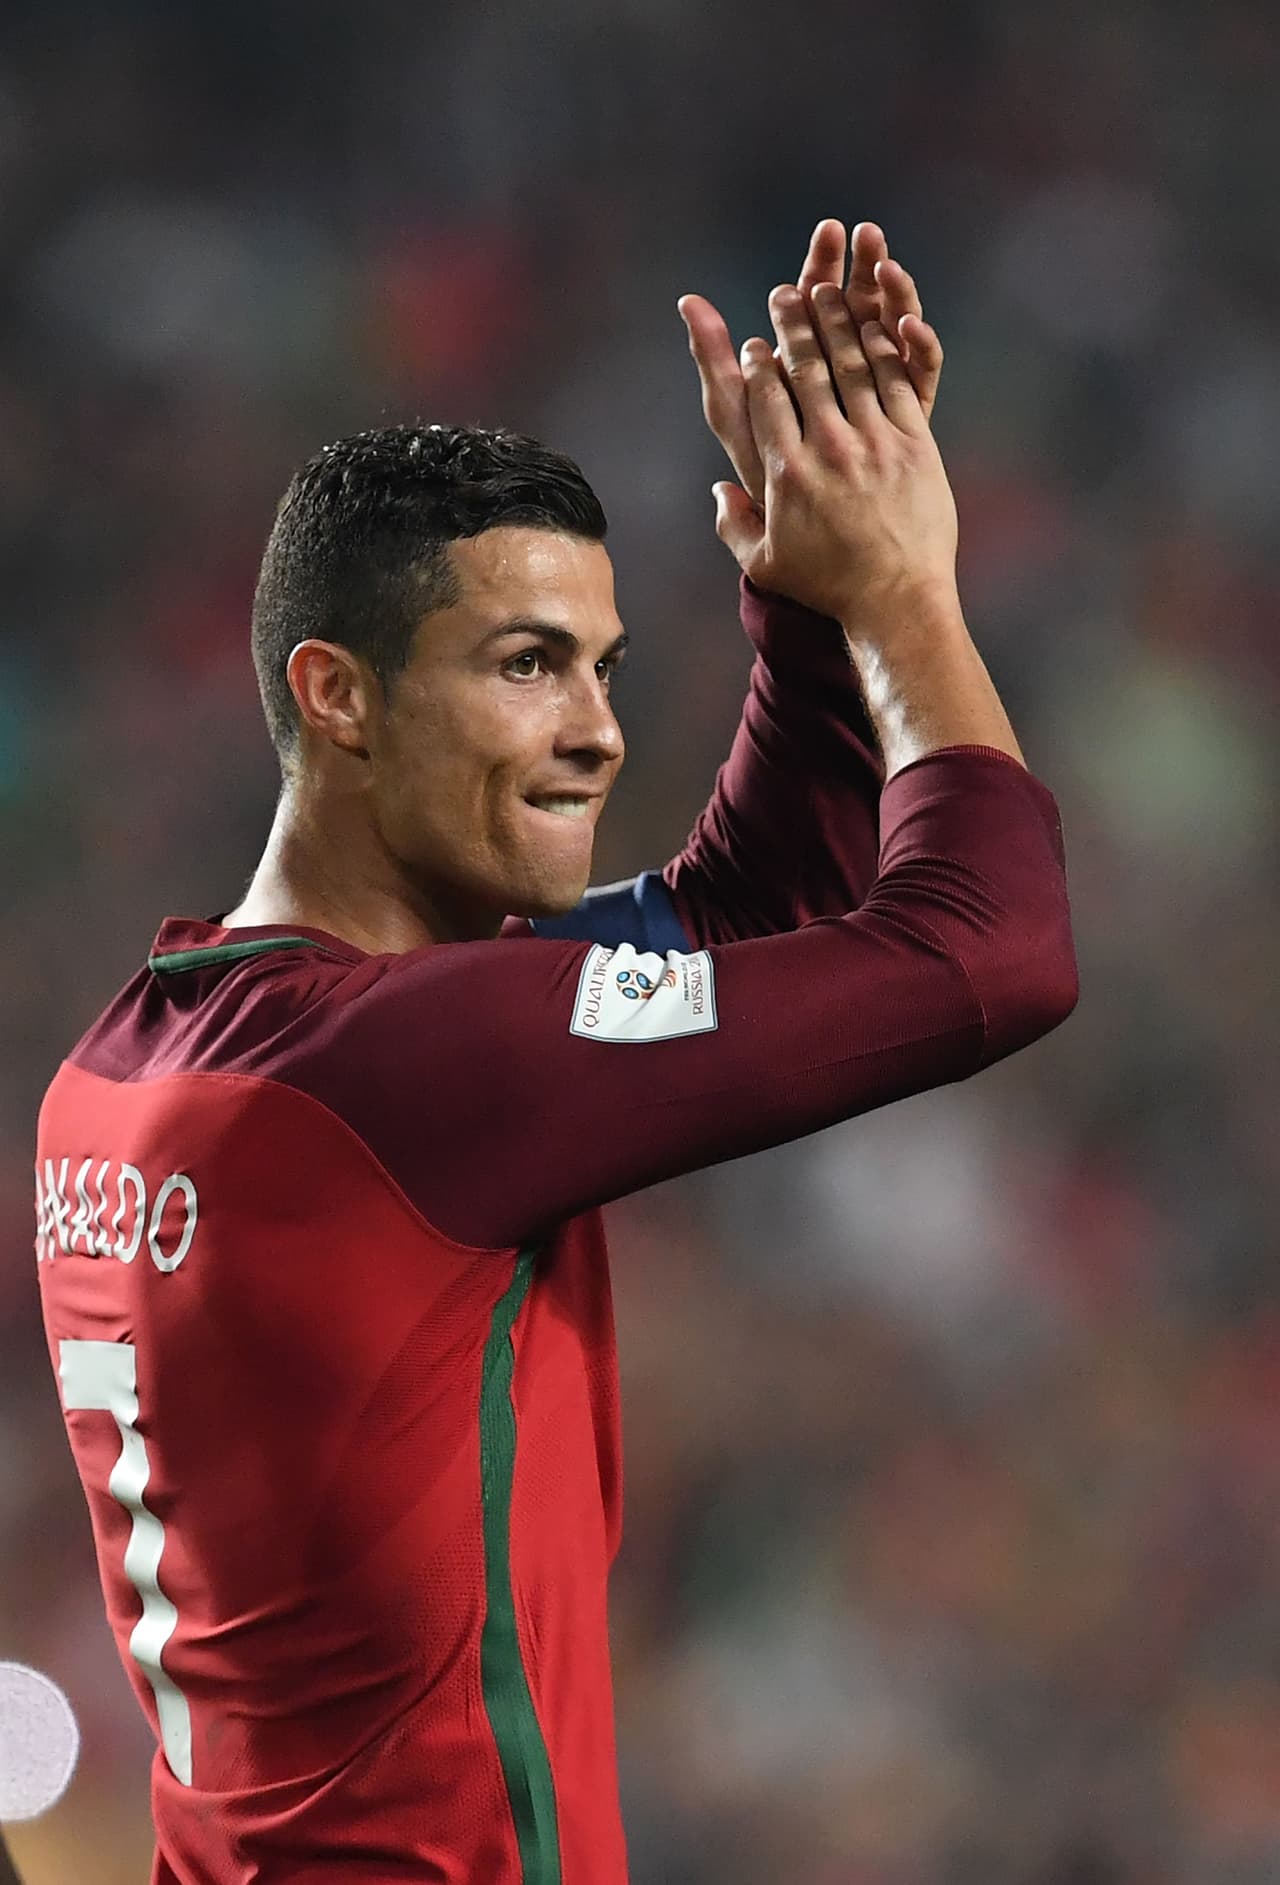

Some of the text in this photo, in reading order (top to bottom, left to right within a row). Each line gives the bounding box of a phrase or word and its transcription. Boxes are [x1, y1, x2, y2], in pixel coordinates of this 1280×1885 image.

[691, 970, 704, 1015] RUSSIA
[34, 1157, 198, 1273] NALDO
[58, 1340, 193, 1787] 7
